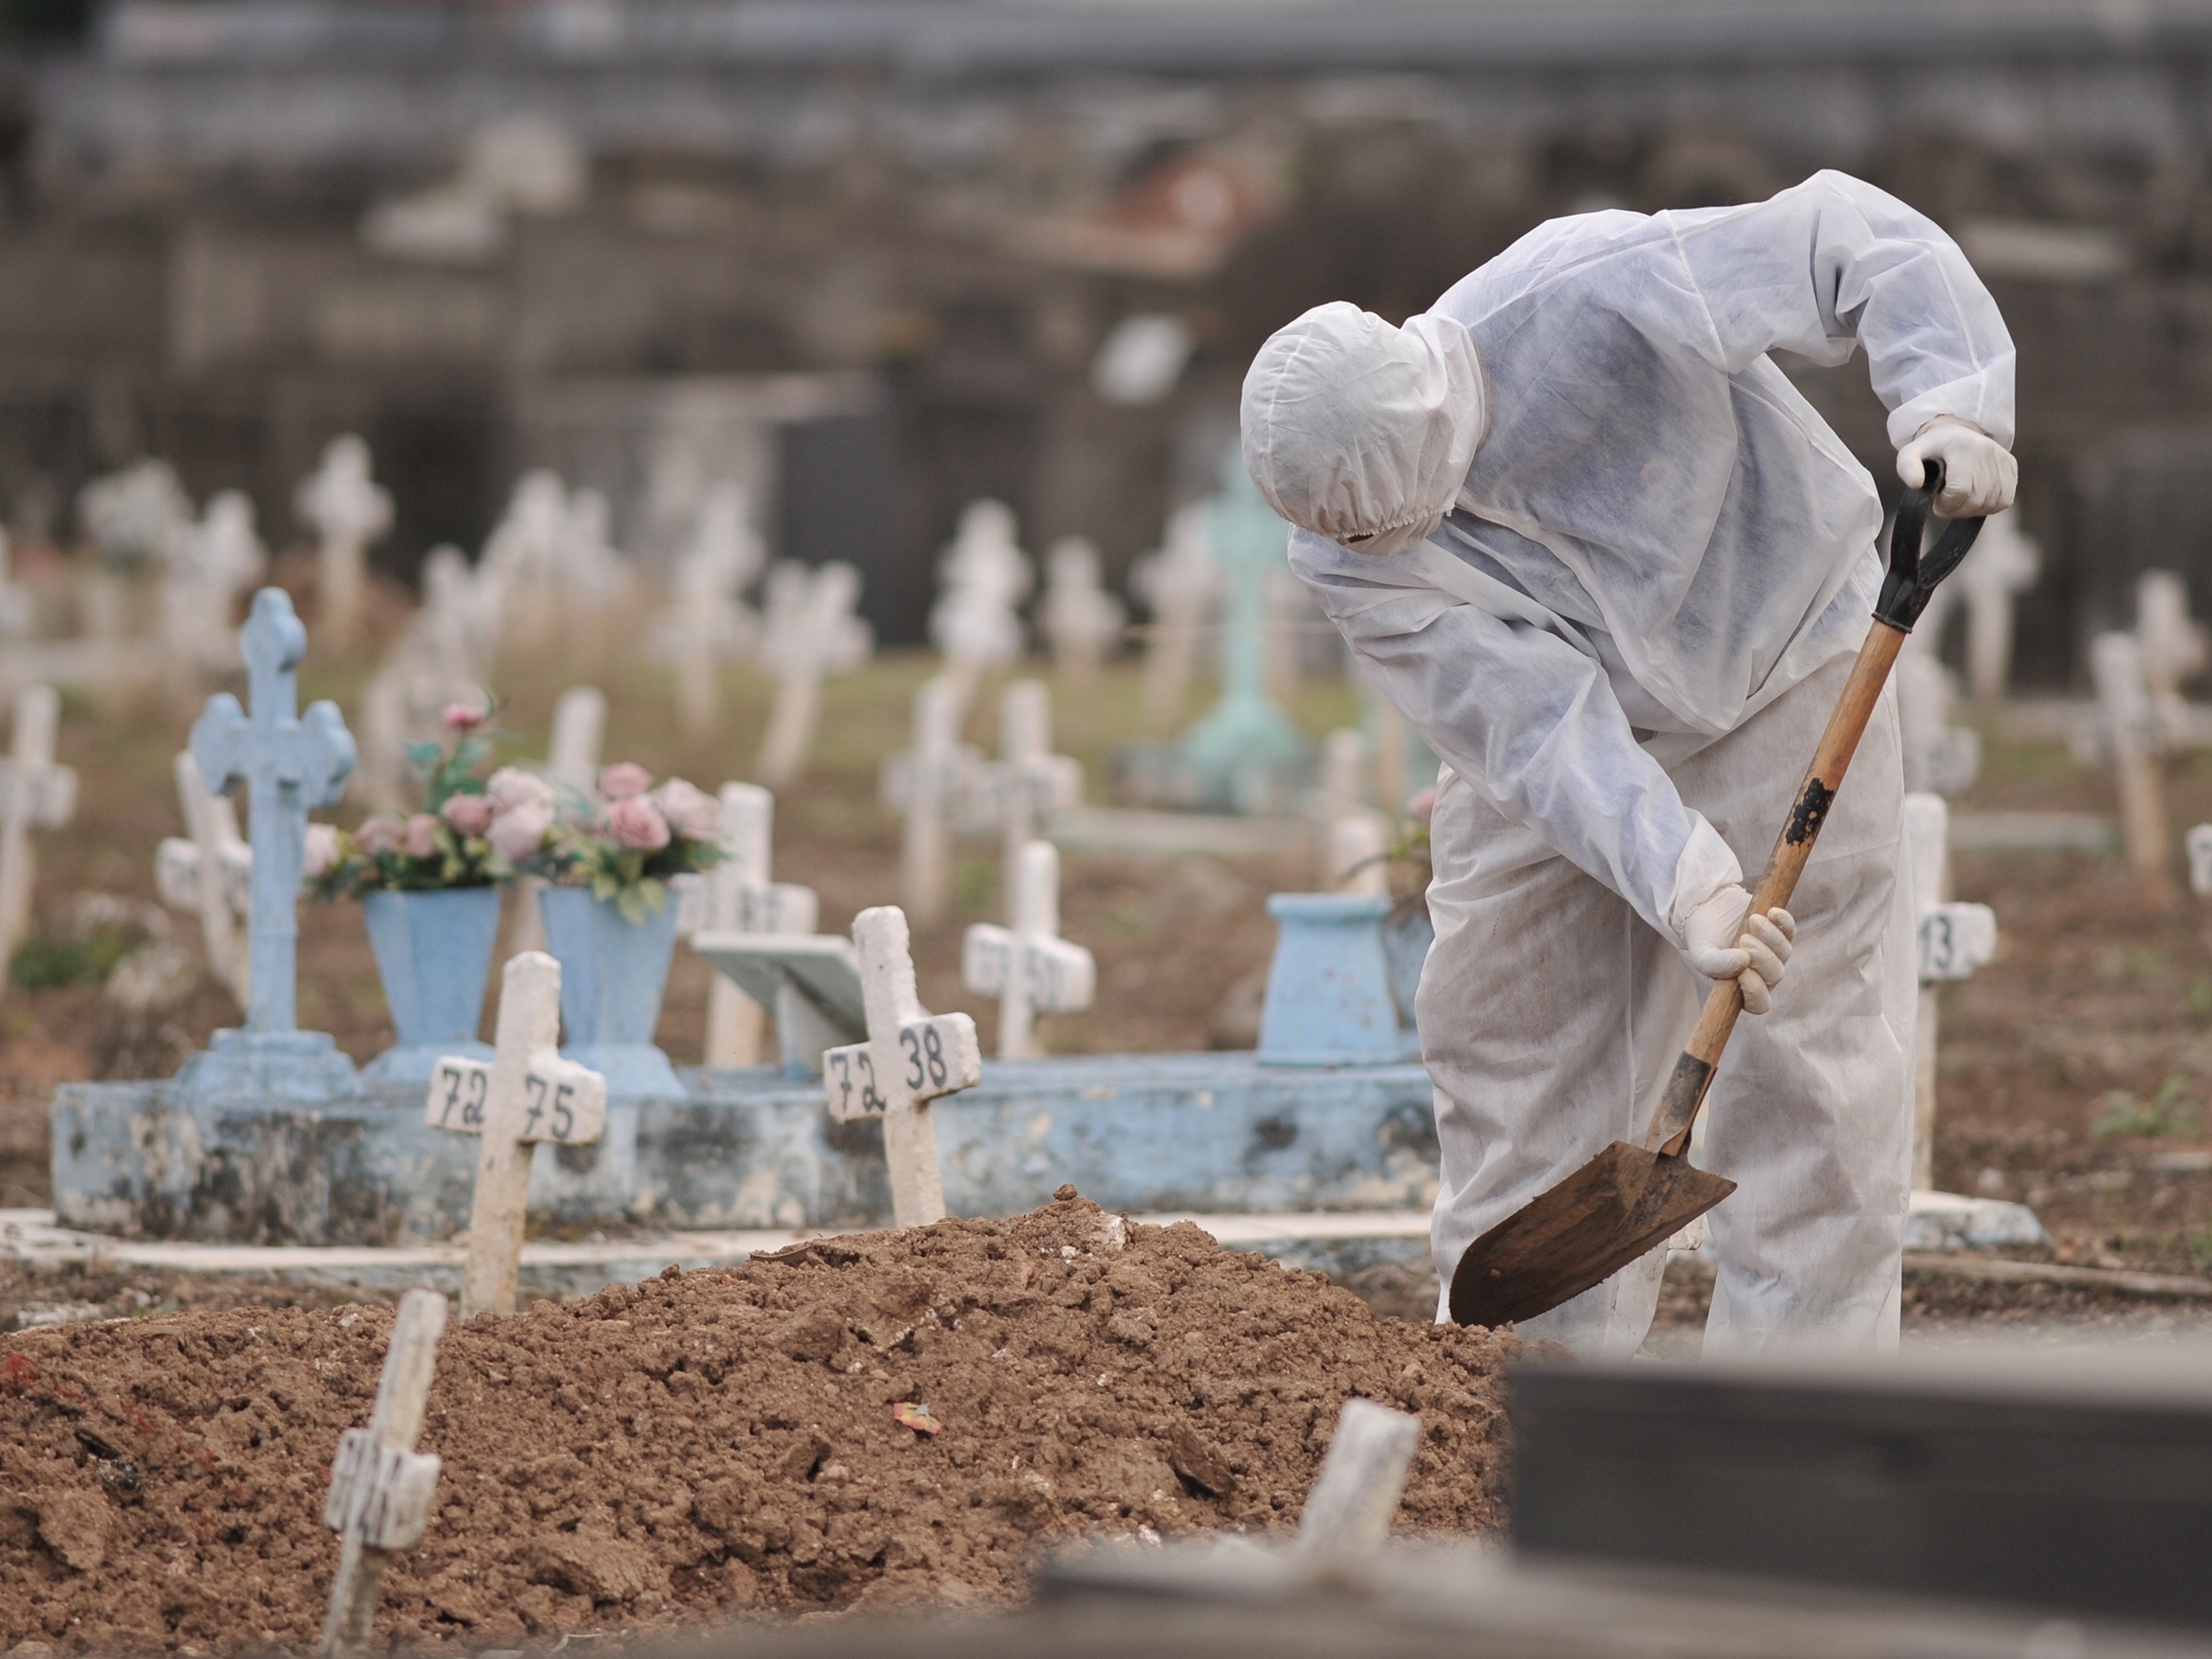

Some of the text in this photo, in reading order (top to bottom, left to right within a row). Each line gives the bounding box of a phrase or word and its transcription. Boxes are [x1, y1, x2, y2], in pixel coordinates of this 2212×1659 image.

[442, 1066, 575, 1140] 72 75
[830, 1023, 948, 1112] 72 38
